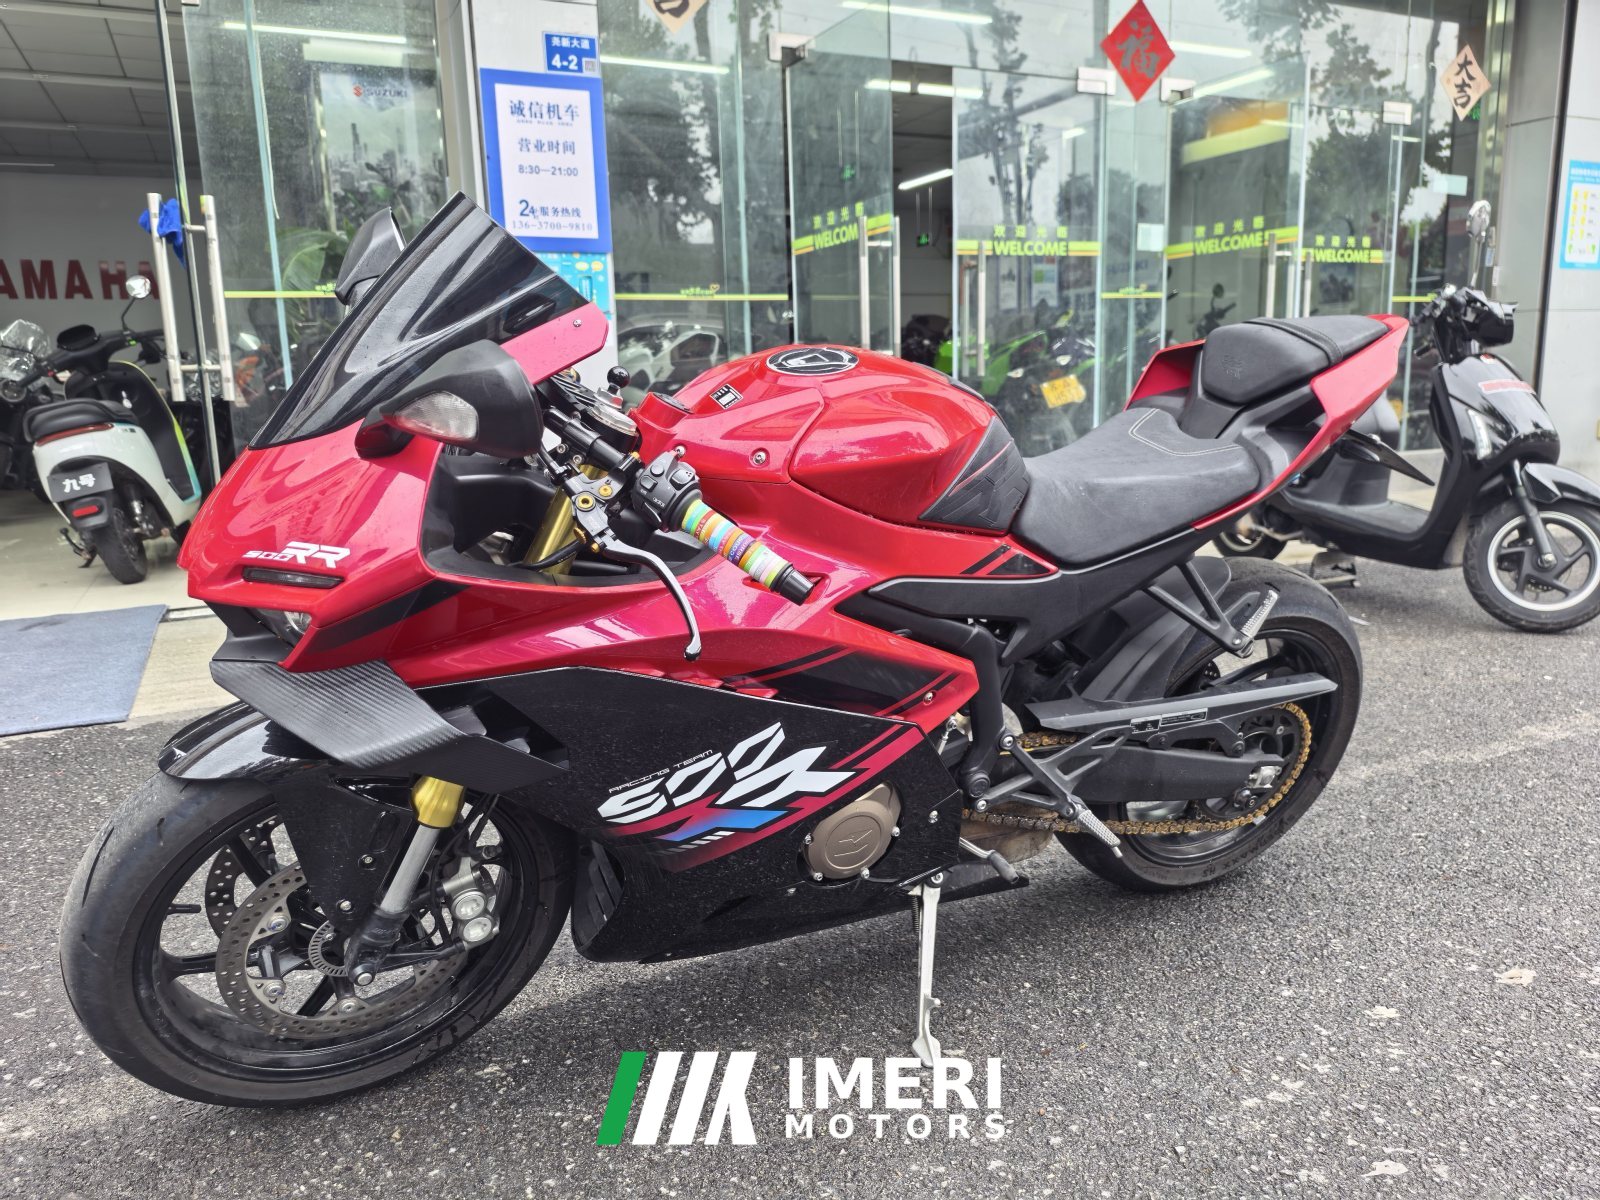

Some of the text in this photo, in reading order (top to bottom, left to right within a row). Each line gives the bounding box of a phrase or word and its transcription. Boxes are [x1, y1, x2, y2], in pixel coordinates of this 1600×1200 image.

[1117, 20, 1160, 78] 福
[551, 53, 579, 70] 4-2
[1454, 52, 1476, 109] 大吉
[366, 87, 408, 98] SUZUKI
[509, 100, 579, 121] 诚信机车
[518, 137, 576, 155] 营业时间
[813, 223, 860, 250] WELCOM
[993, 240, 1067, 257] WELCOME
[1314, 249, 1369, 263] WELCOME
[62, 473, 96, 493] 九号
[608, 749, 714, 793] RACING TEAM
